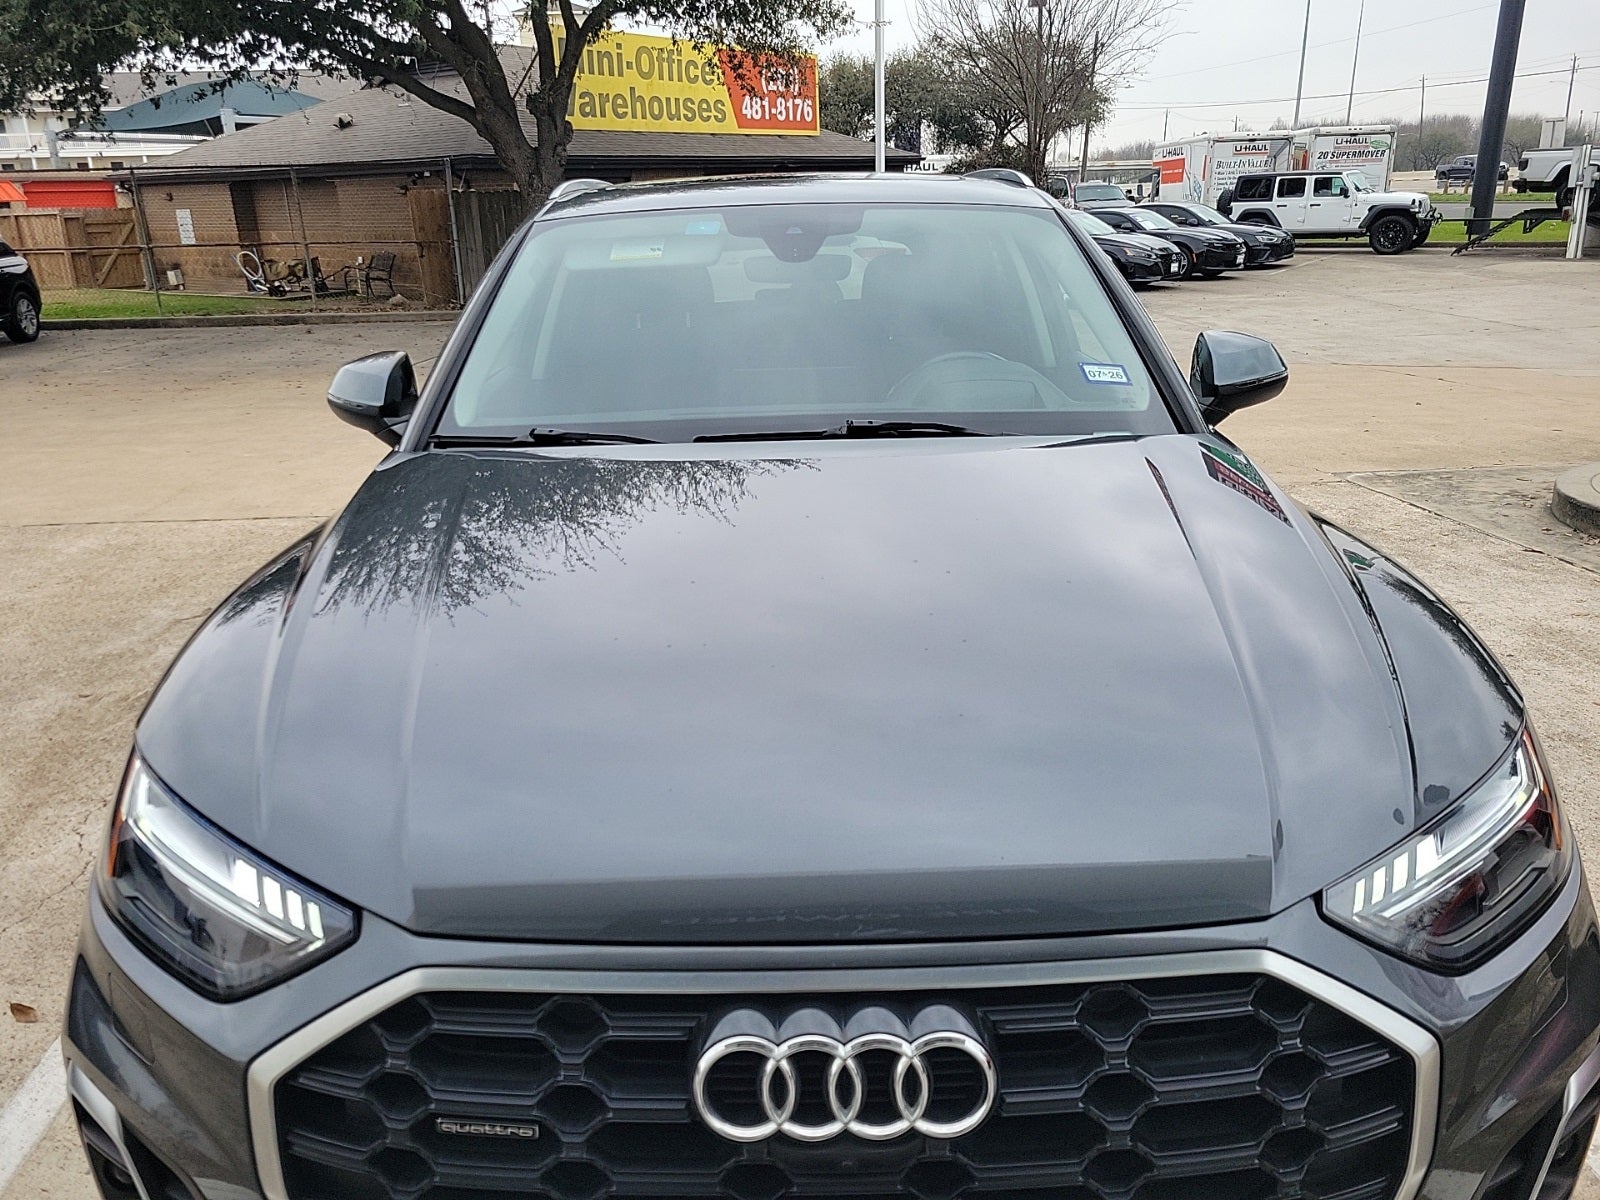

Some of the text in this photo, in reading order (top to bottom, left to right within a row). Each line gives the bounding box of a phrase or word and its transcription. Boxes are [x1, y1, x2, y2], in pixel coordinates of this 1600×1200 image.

[742, 96, 813, 122] 481-8176
[1234, 144, 1268, 152] U-HAUL
[1329, 149, 1386, 159] SUPERMOVER
[1088, 370, 1124, 380] 07 26
[440, 1123, 534, 1137] quattro
